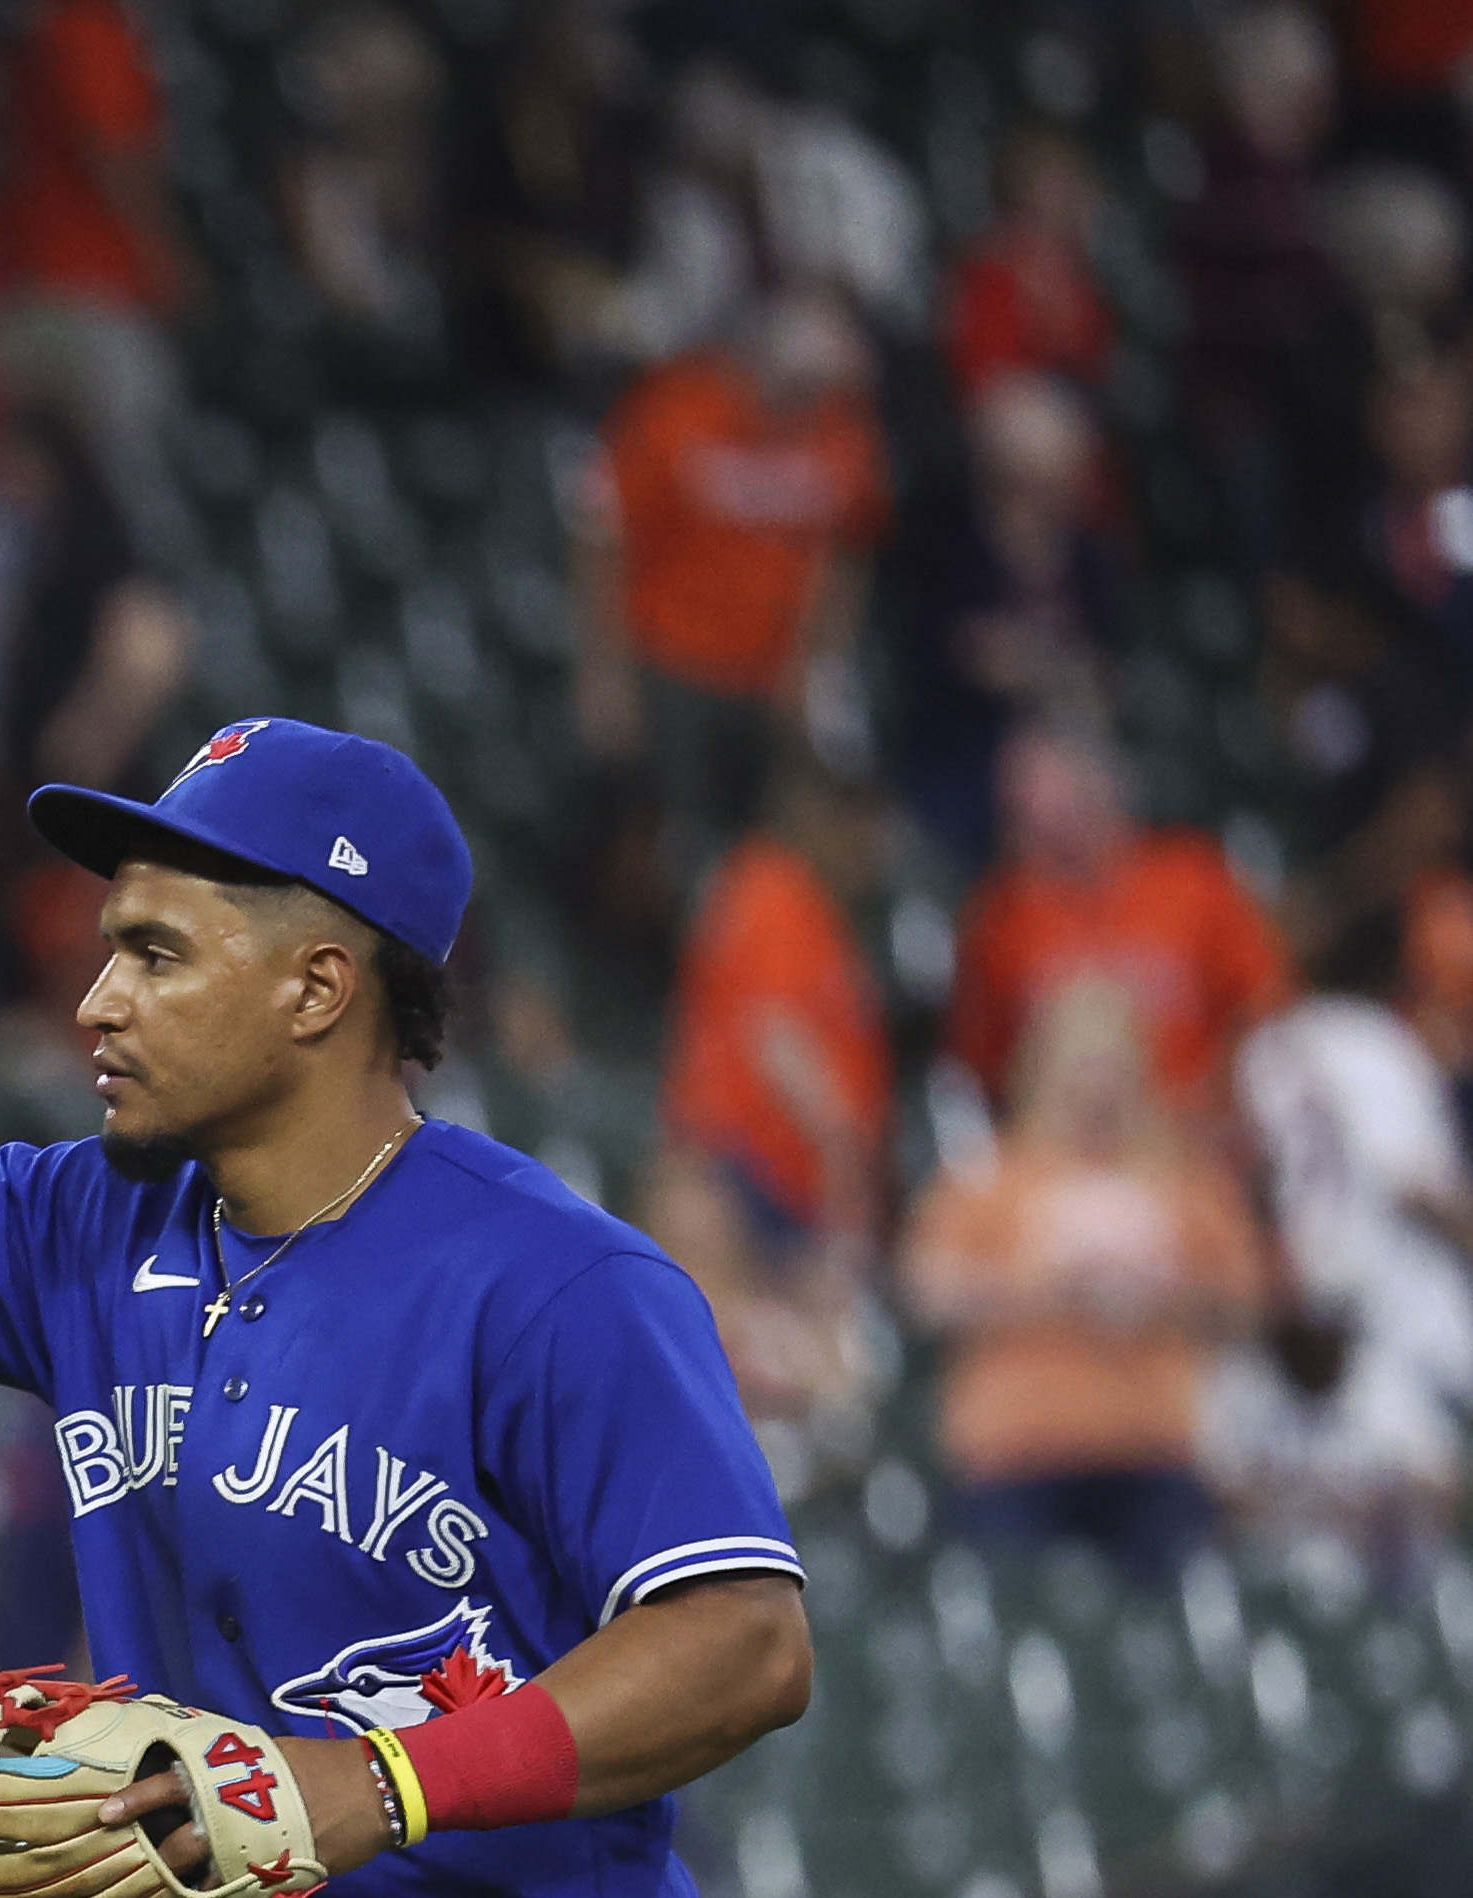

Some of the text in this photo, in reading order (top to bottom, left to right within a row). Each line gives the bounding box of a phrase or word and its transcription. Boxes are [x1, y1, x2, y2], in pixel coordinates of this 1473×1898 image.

[54, 1383, 490, 1589] BUE JAYS
[203, 1731, 279, 1825] 44
